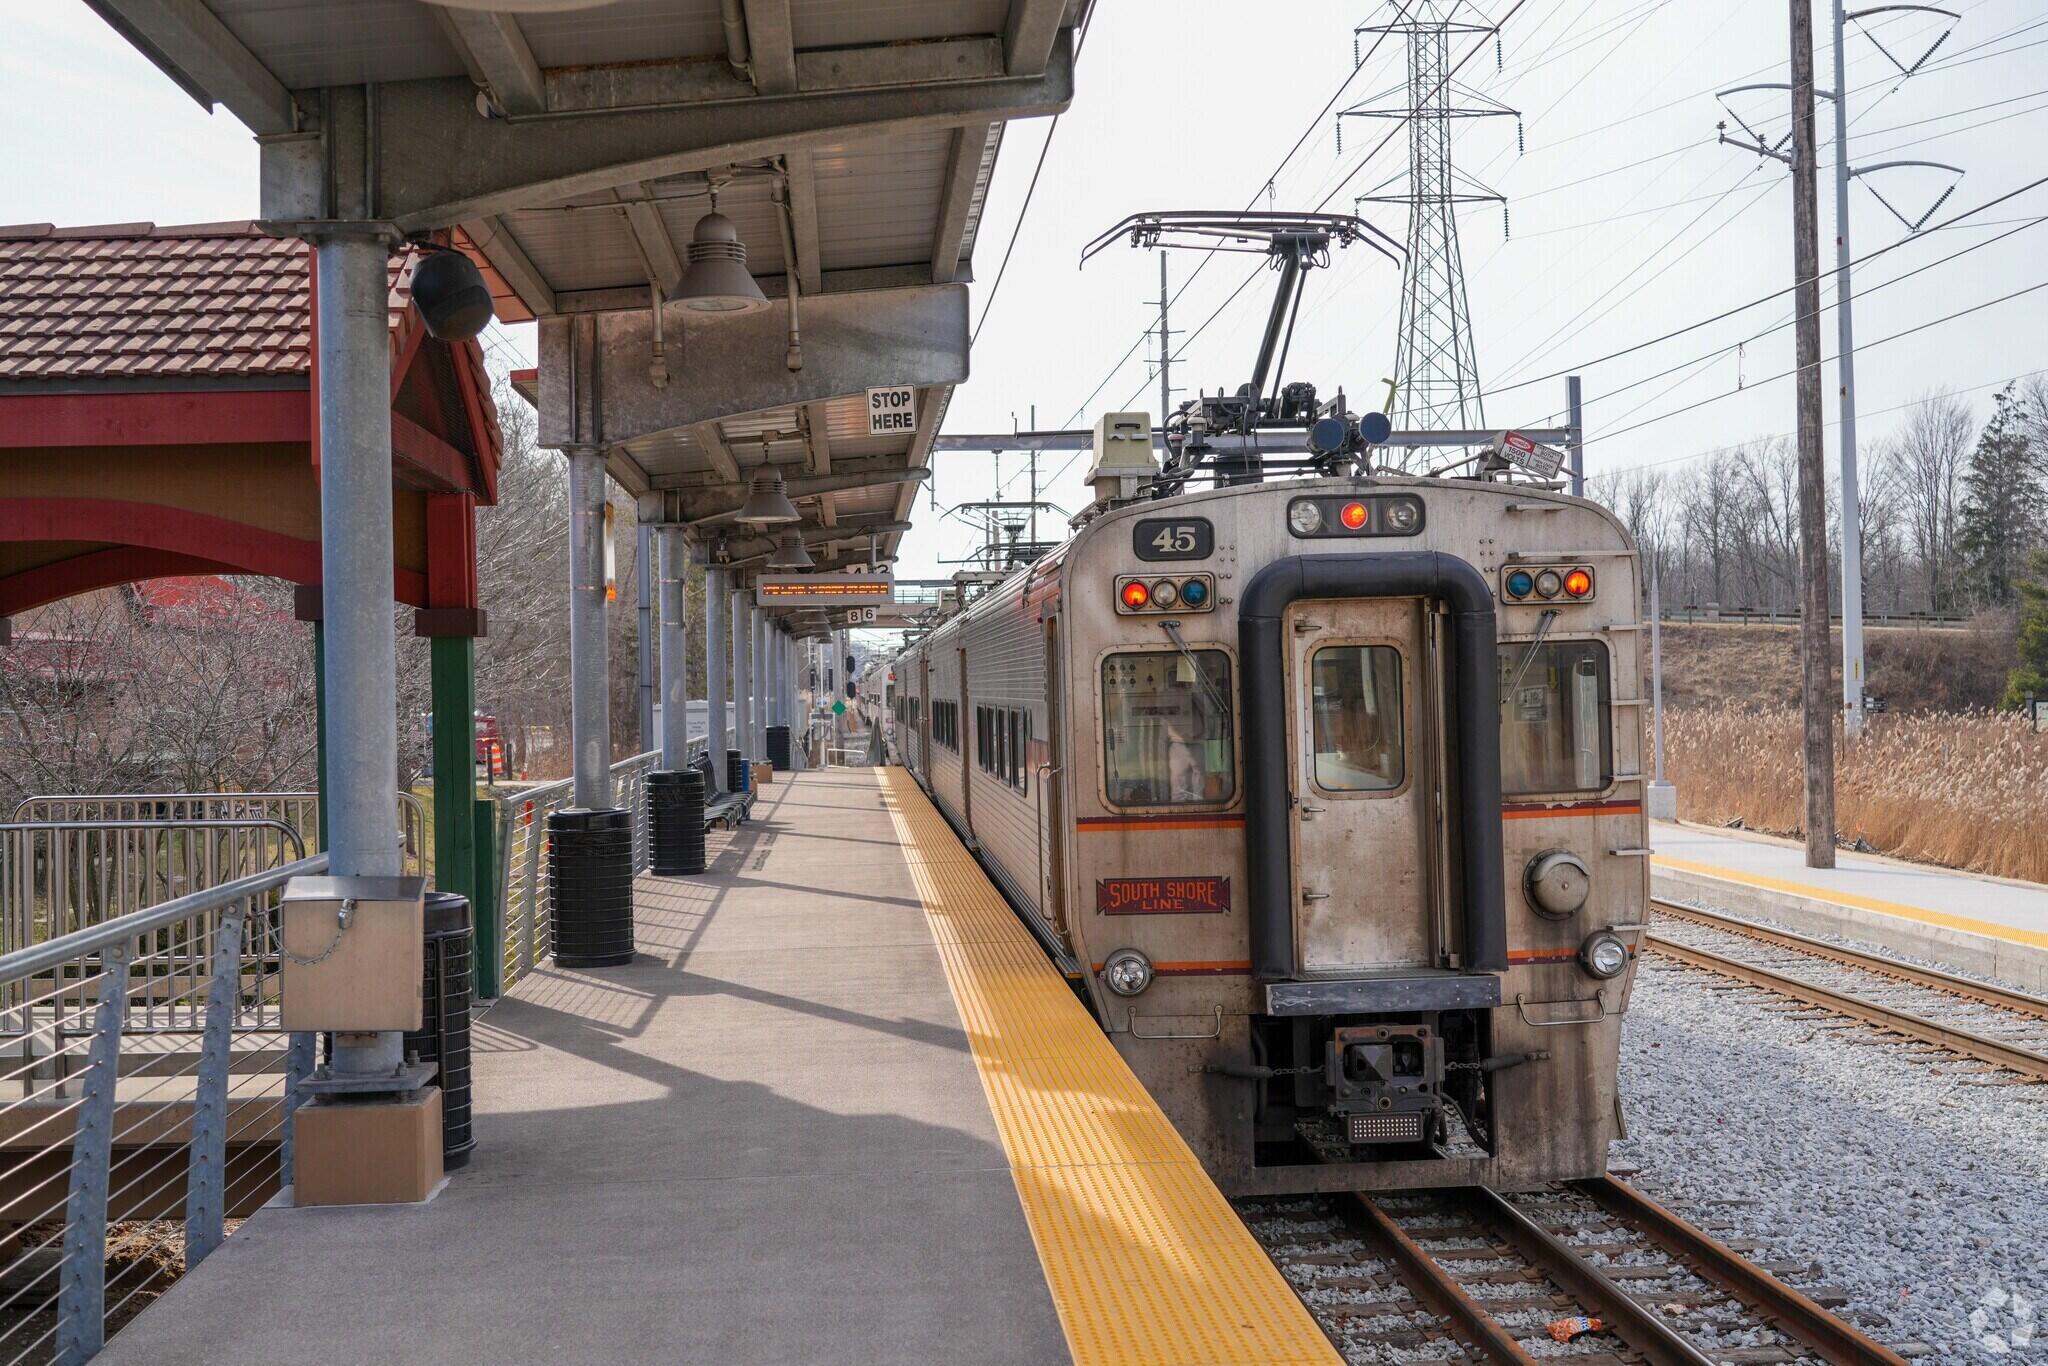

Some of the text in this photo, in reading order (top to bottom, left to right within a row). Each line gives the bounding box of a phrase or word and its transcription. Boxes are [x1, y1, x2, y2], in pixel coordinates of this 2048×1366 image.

[872, 391, 911, 409] STOP
[872, 412, 913, 430] HERE
[1504, 452, 1525, 465] VOLTS
[1508, 446, 1526, 458] 1500
[1151, 526, 1196, 552] 45
[850, 611, 858, 621] 8
[866, 609, 873, 619] 6
[1110, 881, 1217, 908] SOUTH SHORE
[1142, 899, 1184, 910] LINE
